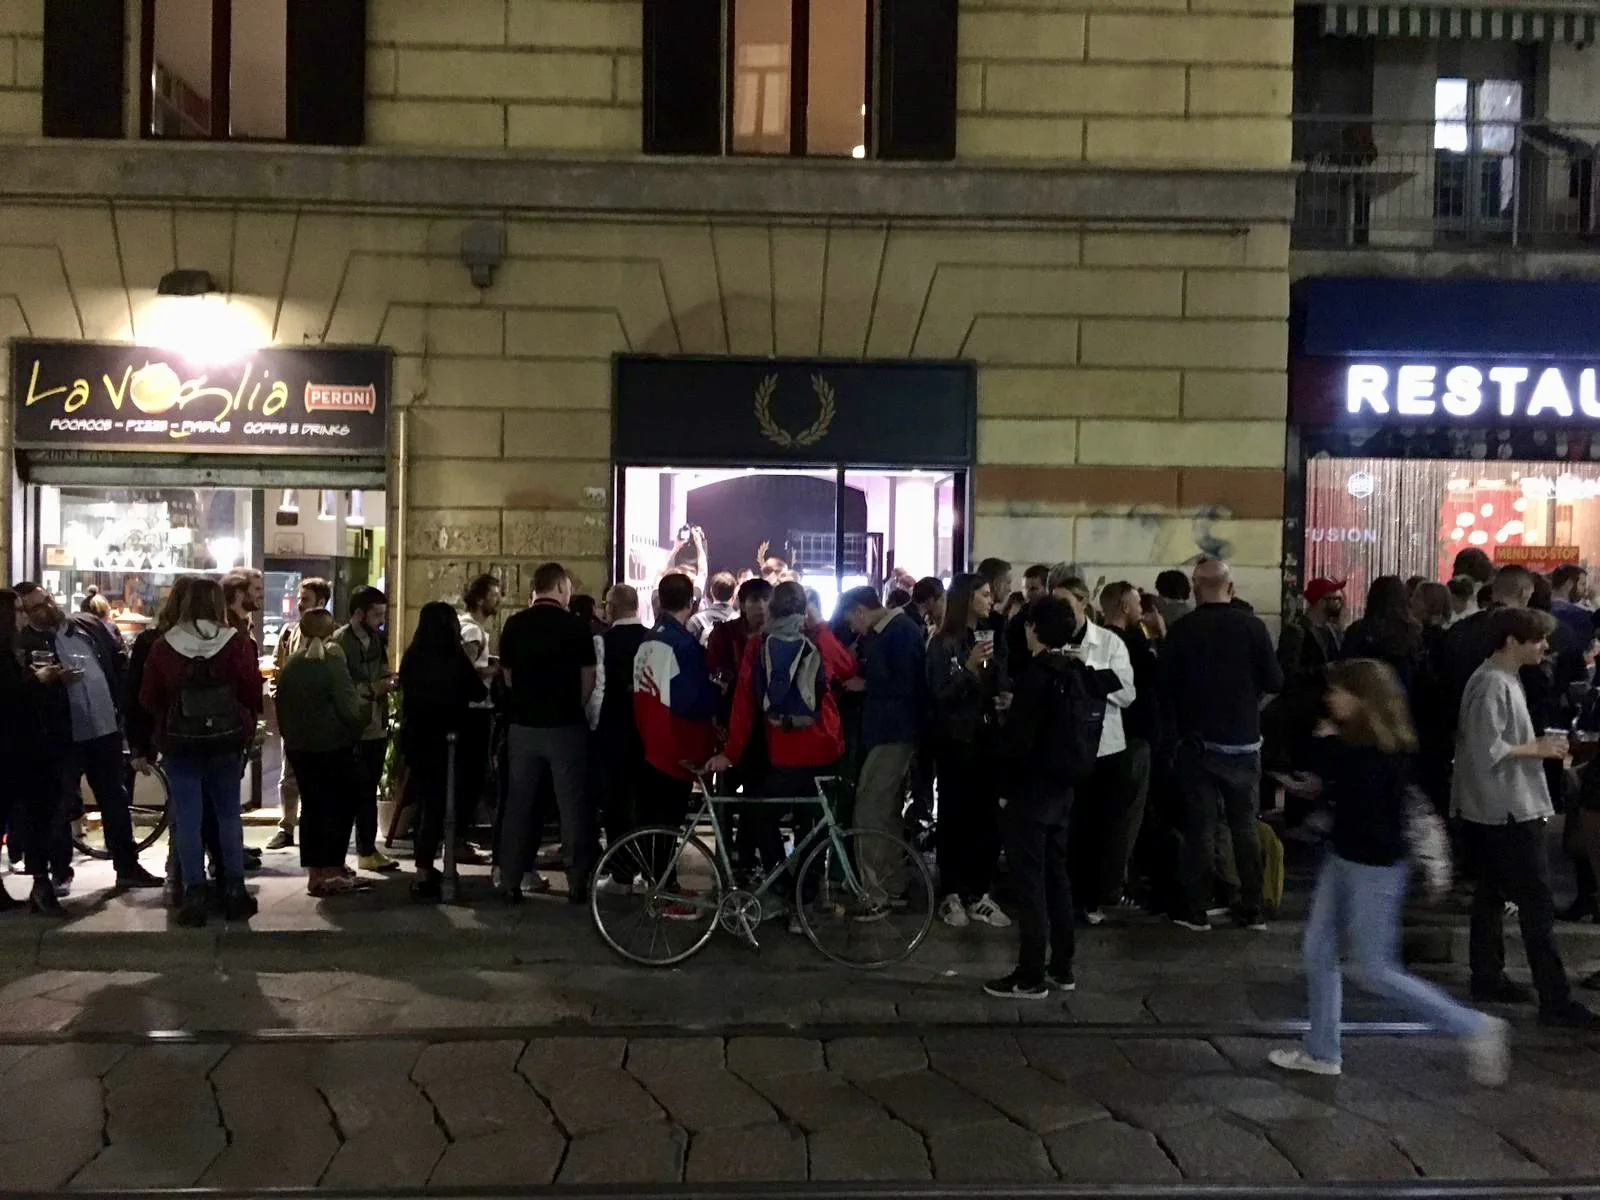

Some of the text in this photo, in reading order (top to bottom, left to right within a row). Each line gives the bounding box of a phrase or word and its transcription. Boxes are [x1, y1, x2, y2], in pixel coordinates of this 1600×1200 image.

[26, 359, 89, 414] La
[311, 391, 370, 405] PERONI
[301, 423, 350, 436] DRINKS
